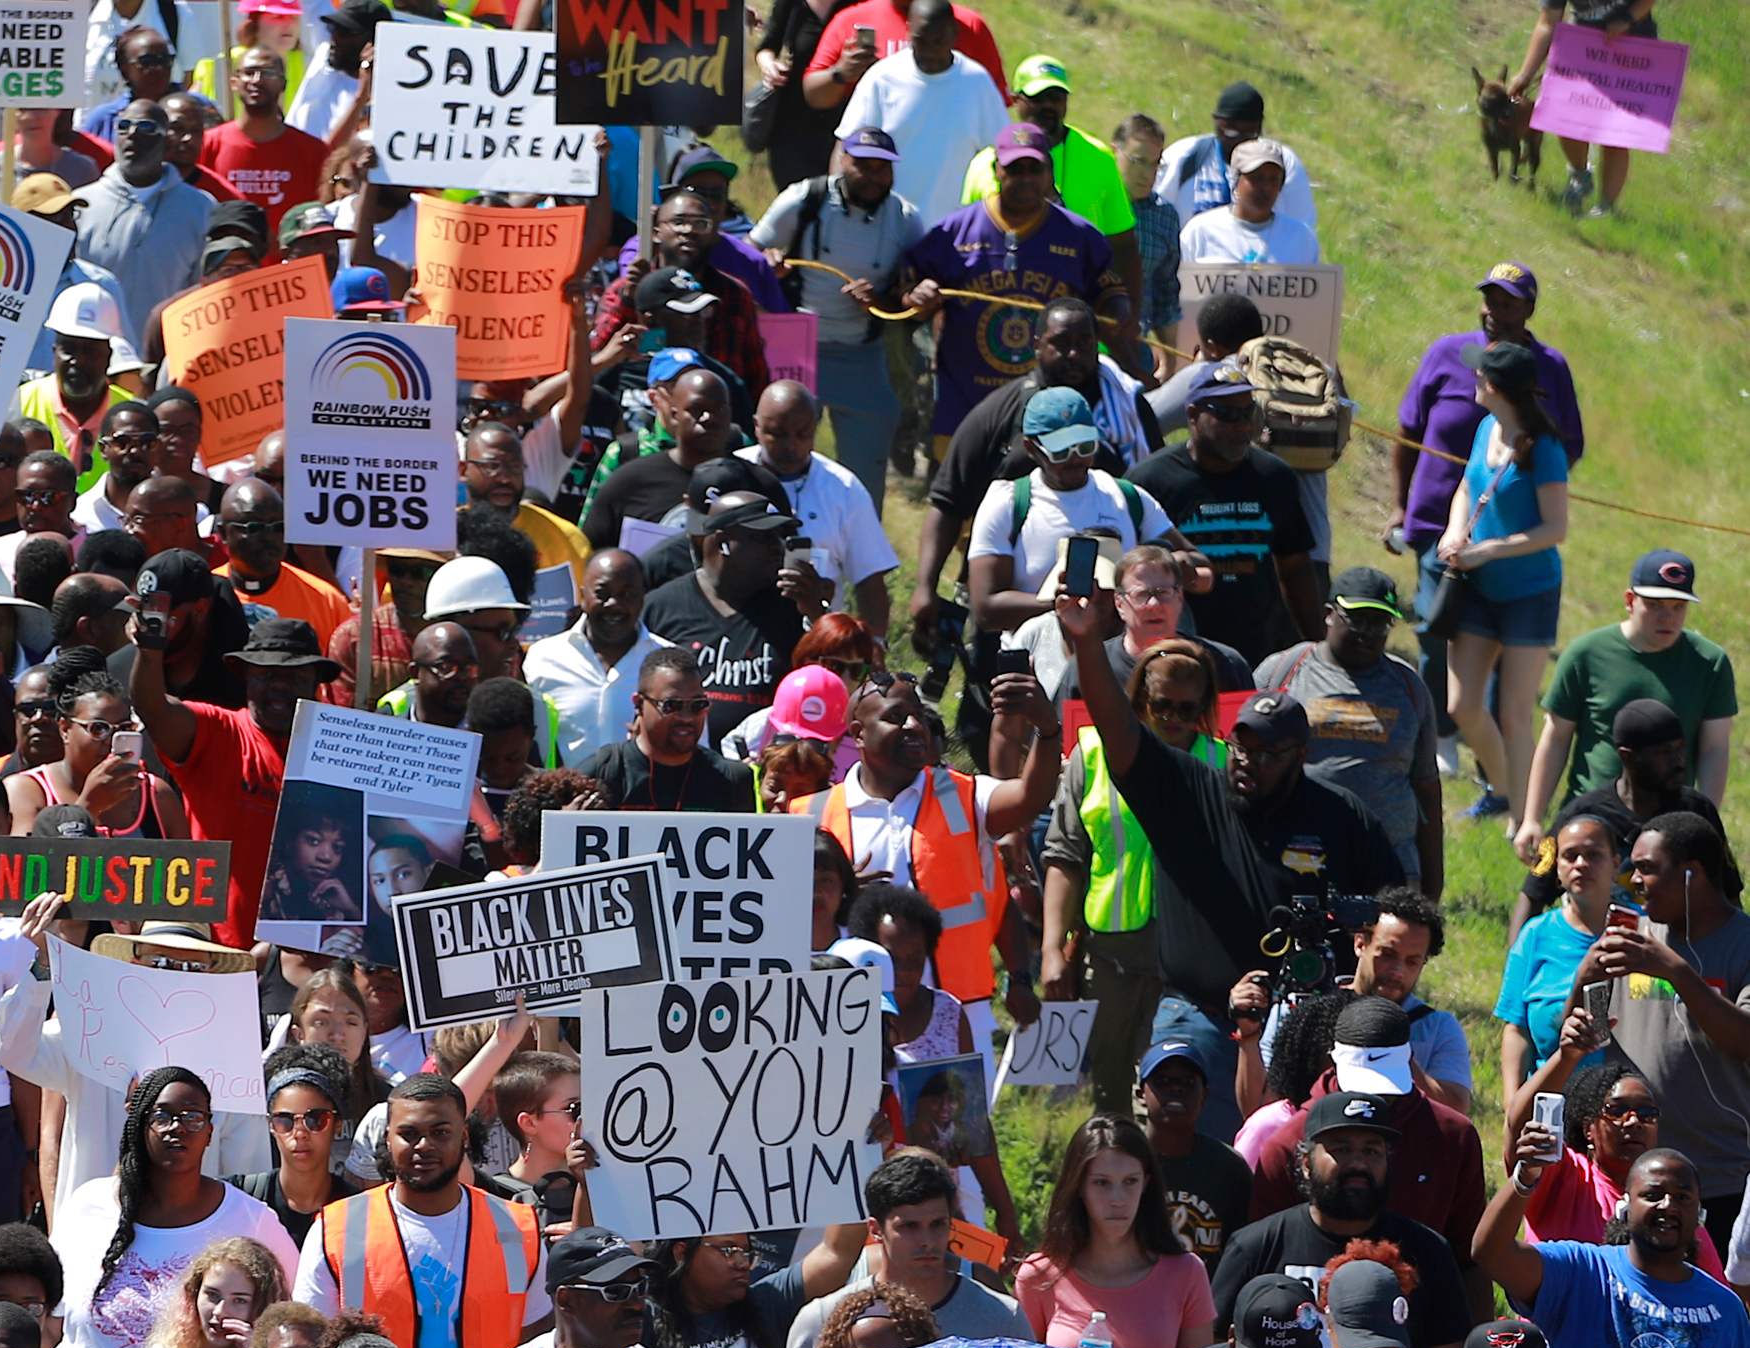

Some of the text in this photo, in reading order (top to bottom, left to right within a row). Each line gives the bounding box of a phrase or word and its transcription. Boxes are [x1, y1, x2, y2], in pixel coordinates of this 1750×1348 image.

[1, 10, 74, 20] THE BORDER
[2, 23, 62, 40] NEED
[396, 45, 556, 98] SAVE
[605, 30, 728, 107] Heard
[1585, 48, 1652, 69] WE NEED
[1615, 77, 1673, 97] HEALTH
[444, 102, 526, 127] THE
[433, 219, 558, 248] STOP THIS
[426, 262, 556, 294] SENSELESS
[1246, 275, 1317, 298] NEED
[181, 276, 307, 337] STOP THIS
[317, 416, 424, 427] COALITION
[301, 453, 438, 471] BEHIND THE BORDER
[308, 470, 426, 492] WE NEED
[305, 493, 429, 530] JOBS
[318, 713, 468, 748] Senseless murder causes
[320, 728, 461, 761] more than Those
[311, 752, 325, 763] be
[314, 740, 463, 775] that are taken can never
[353, 776, 413, 793] and Tyler
[62, 855, 216, 906] JUSTICE
[429, 878, 635, 956] BLACK LIVES
[494, 939, 586, 987] MATTER
[541, 982, 561, 995] More
[604, 969, 870, 1056] LOOKING
[604, 1047, 853, 1163] @ YOU
[646, 1140, 867, 1234] RAHM
[1262, 1315, 1299, 1331] House
[1265, 1334, 1296, 1348] Hope
